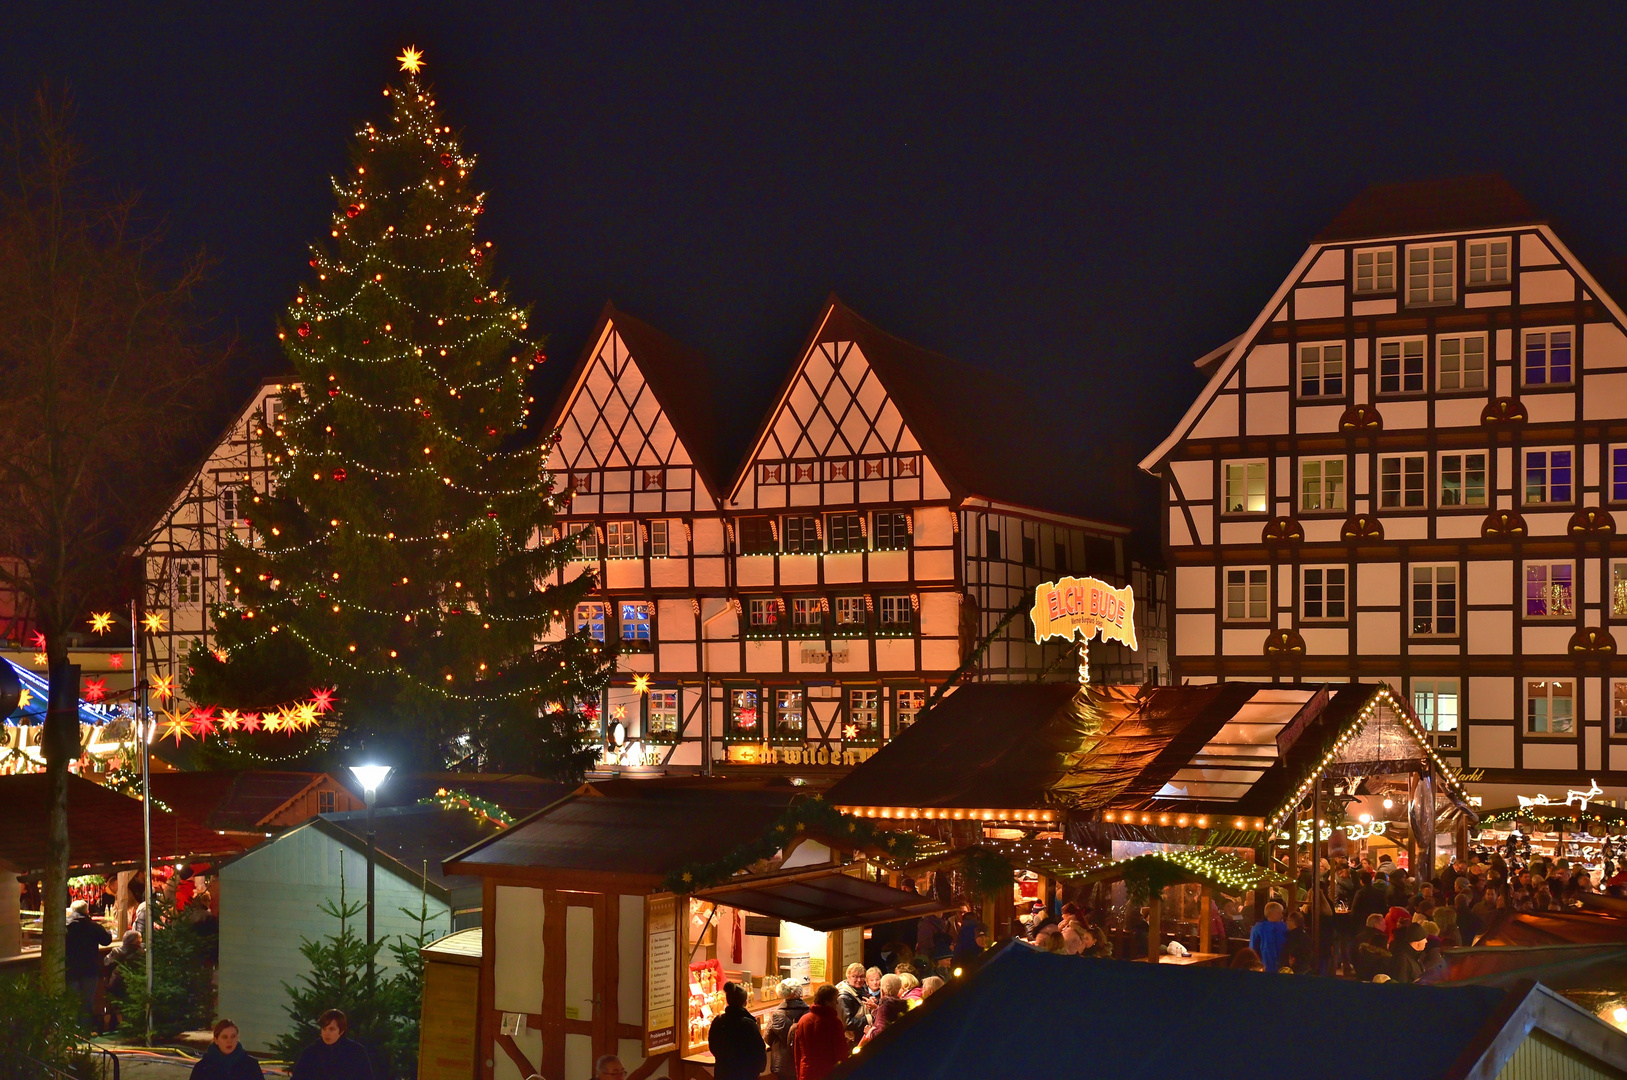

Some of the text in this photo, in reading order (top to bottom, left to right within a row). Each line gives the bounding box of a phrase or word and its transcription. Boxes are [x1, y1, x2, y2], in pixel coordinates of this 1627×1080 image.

[1047, 586, 1126, 629] ELCH BUDE
[801, 649, 849, 664] Hotel
[784, 744, 856, 766] wilden
